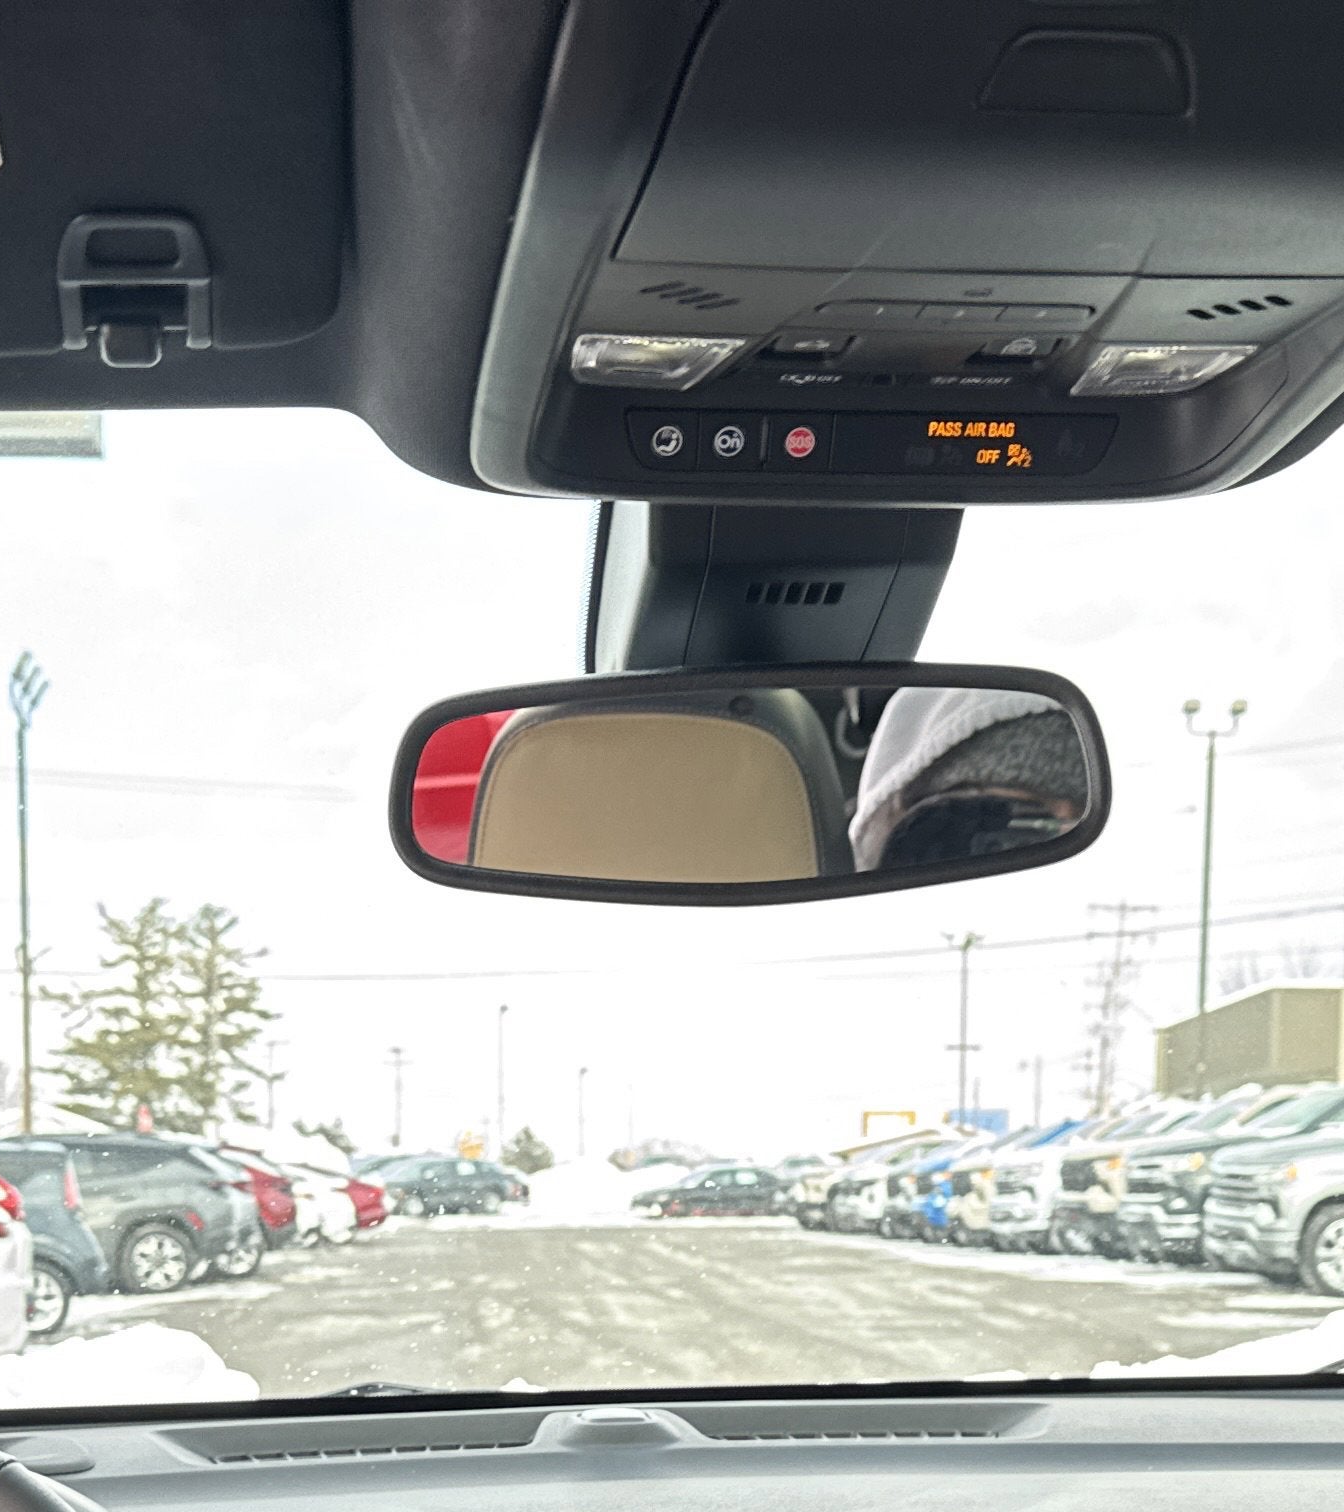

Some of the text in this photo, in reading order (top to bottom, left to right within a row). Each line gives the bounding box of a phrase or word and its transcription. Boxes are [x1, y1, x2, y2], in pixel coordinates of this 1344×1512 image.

[928, 421, 1016, 439] PASS AIR BAG
[717, 433, 740, 449] On
[787, 435, 814, 449] SOS
[975, 448, 1001, 465] OFF
